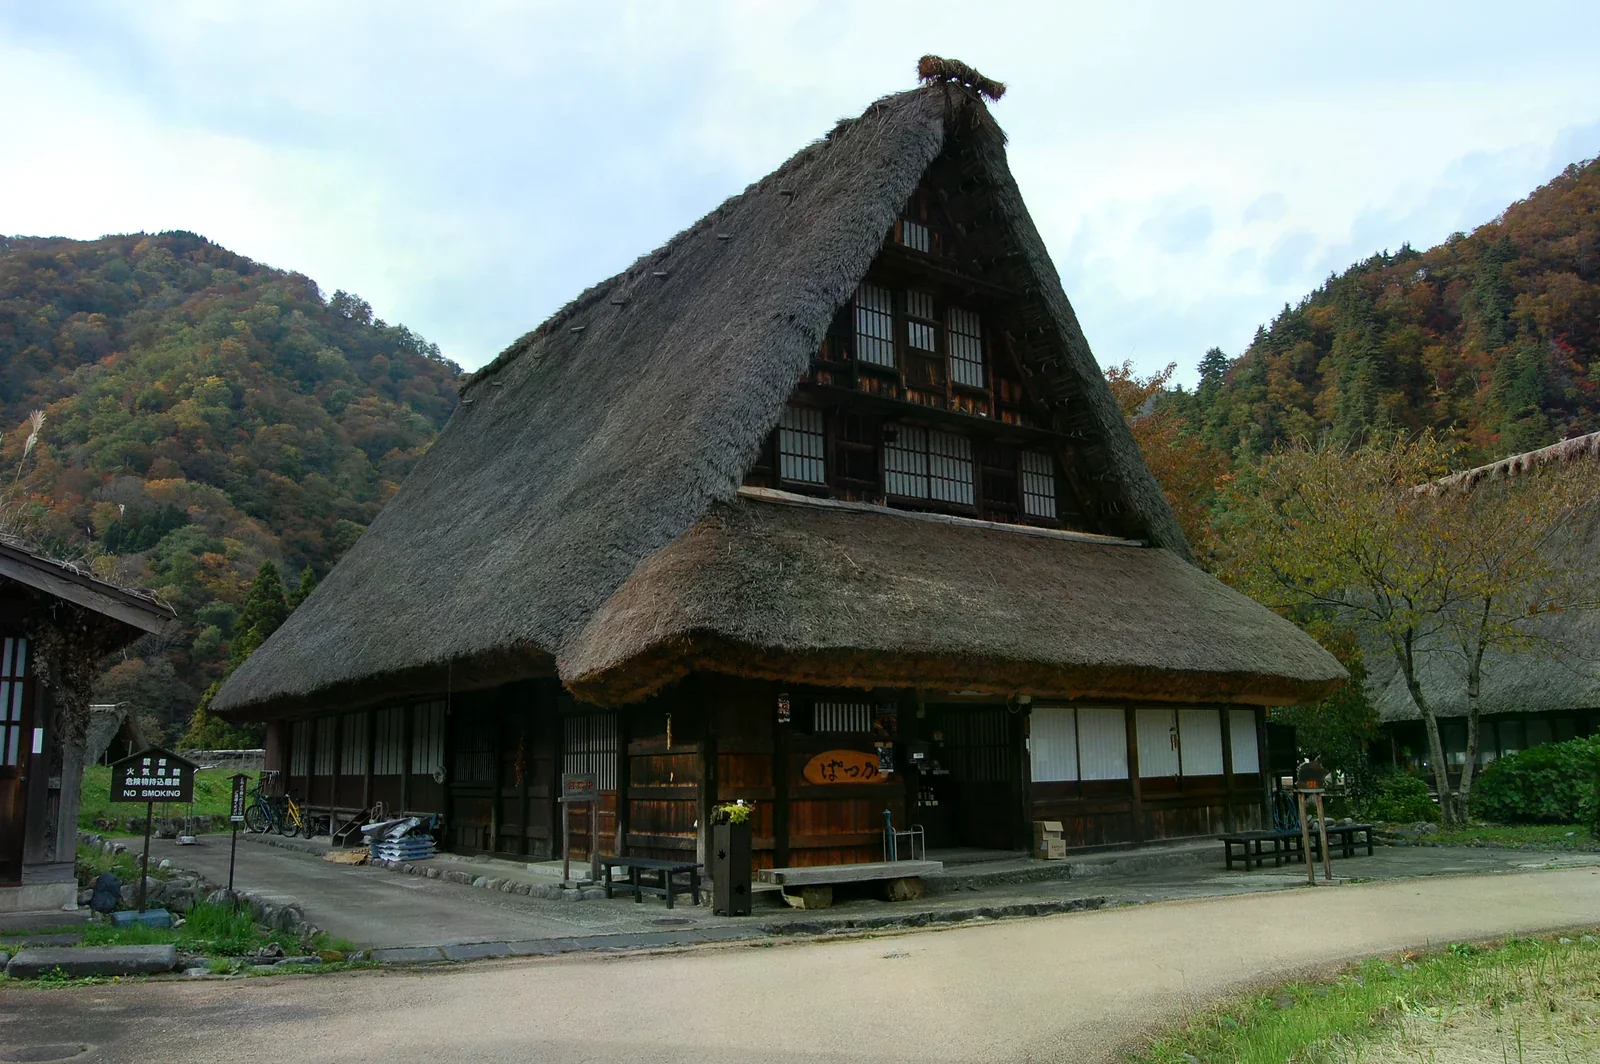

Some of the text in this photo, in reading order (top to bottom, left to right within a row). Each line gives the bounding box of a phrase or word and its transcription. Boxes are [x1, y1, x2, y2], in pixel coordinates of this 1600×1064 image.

[126, 778, 180, 786] 危険物持込厳禁
[123, 789, 181, 797] NO SMOKING
